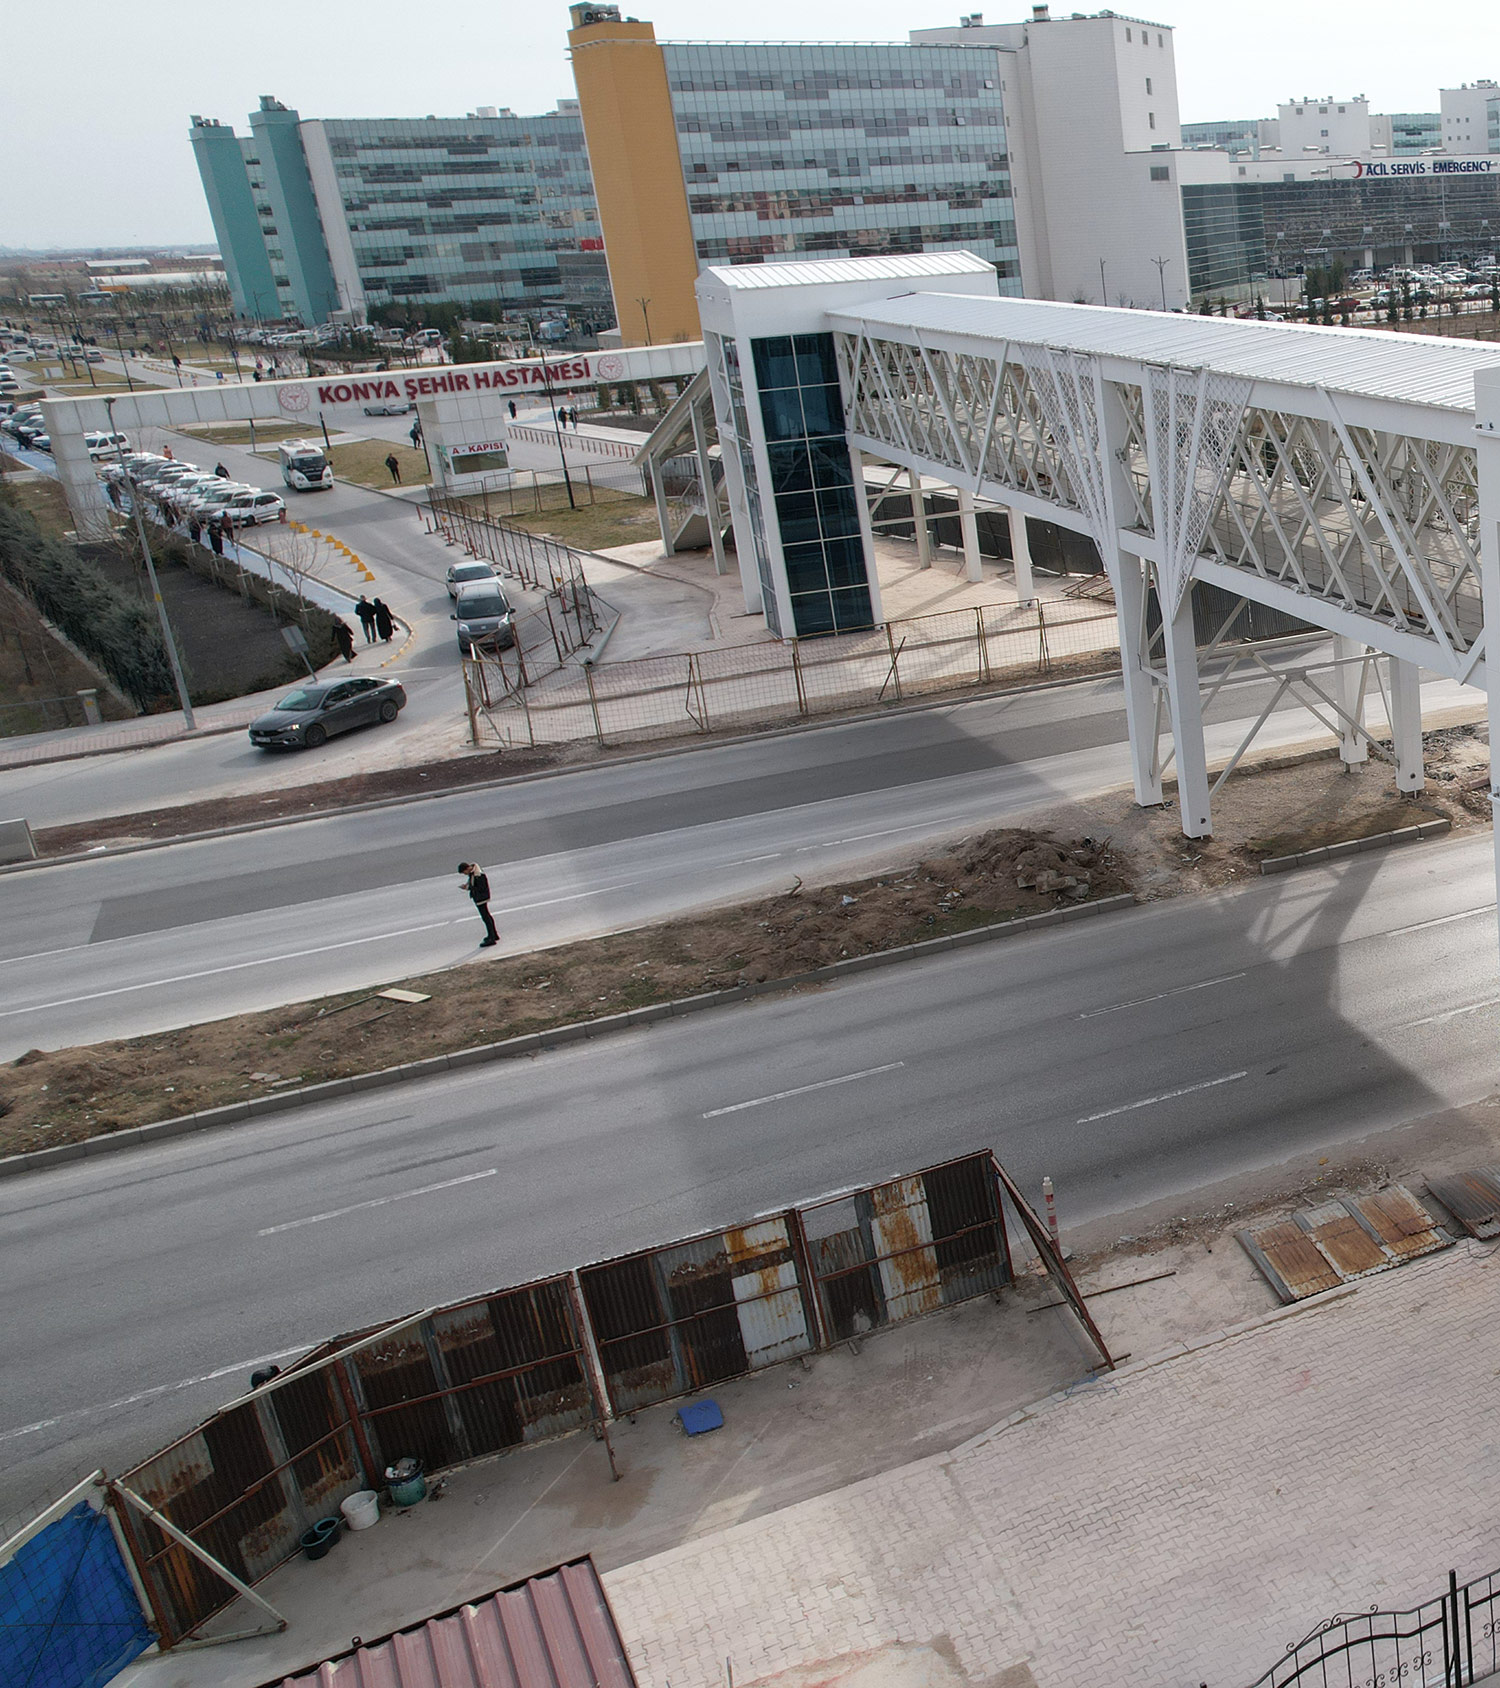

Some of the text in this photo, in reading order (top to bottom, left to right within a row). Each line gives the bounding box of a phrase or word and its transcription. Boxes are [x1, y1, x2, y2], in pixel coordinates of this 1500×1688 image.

[1366, 162, 1389, 176] ACİL
[1391, 161, 1426, 175] SERVİS
[1432, 160, 1492, 174] EMERGENCY
[318, 358, 591, 404] KONYA ŞEHİR HASTANESİ
[468, 442, 503, 453] KAPISI
